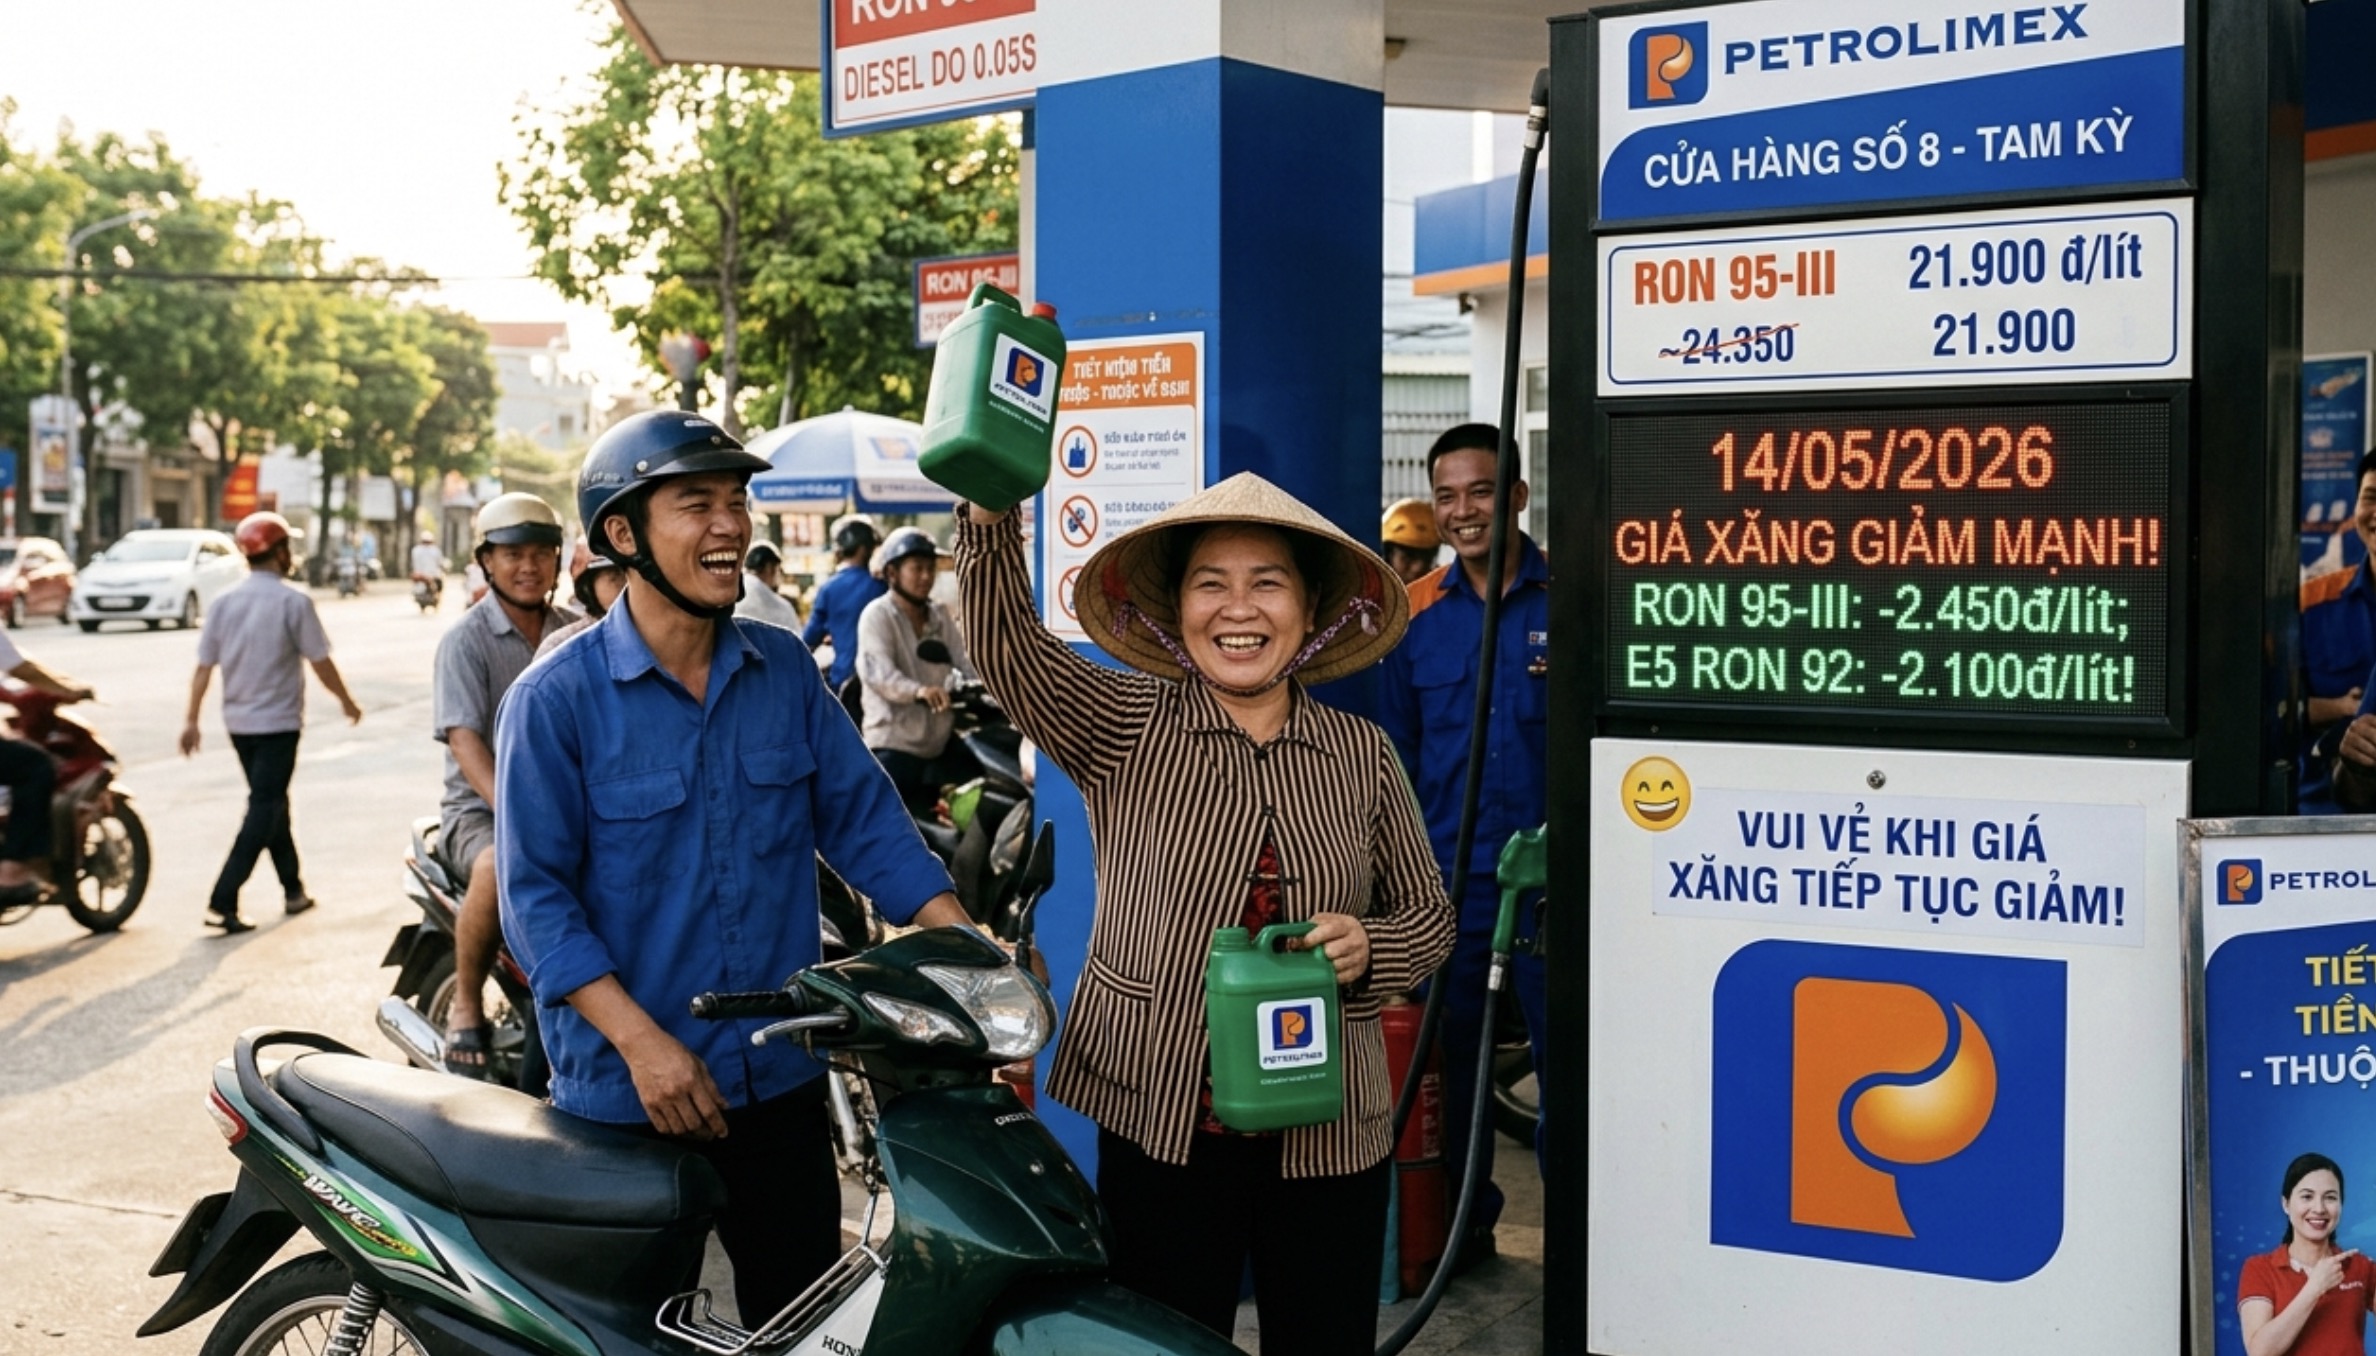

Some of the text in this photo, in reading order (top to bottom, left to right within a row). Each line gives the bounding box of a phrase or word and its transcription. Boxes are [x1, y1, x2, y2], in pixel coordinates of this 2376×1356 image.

[844, 33, 1037, 101] DIESEL DO 0.05S
[1724, 3, 2088, 75] PETROLIMEX
[1644, 139, 1721, 188] CỬA
[1732, 136, 1840, 181] HÀNG
[1852, 119, 1908, 172] SỐ
[1918, 132, 1940, 167] 8
[1976, 121, 2062, 162] TAM
[2076, 106, 2134, 154] KỲ
[926, 269, 968, 296] RON
[1635, 250, 1835, 305] RON 95-III
[1909, 232, 2142, 289] 21.900 đ/lít
[1933, 307, 2075, 356] 21.900
[1712, 426, 2053, 491] 14/05/2026
[1616, 504, 2159, 575] GIÁ XĂNG GIẢM MẠNH!
[1635, 583, 2128, 642] RON 95-III: -2.450đ/lít;
[1627, 645, 2134, 703] E5 RON 92: -2.100đ/lít!
[1737, 801, 2047, 863] VUI VẺ KHI GIÁ
[1669, 853, 2125, 926] XĂNG TIẾP TỤC GIẢM!
[2264, 1044, 2376, 1090] THUỘ
